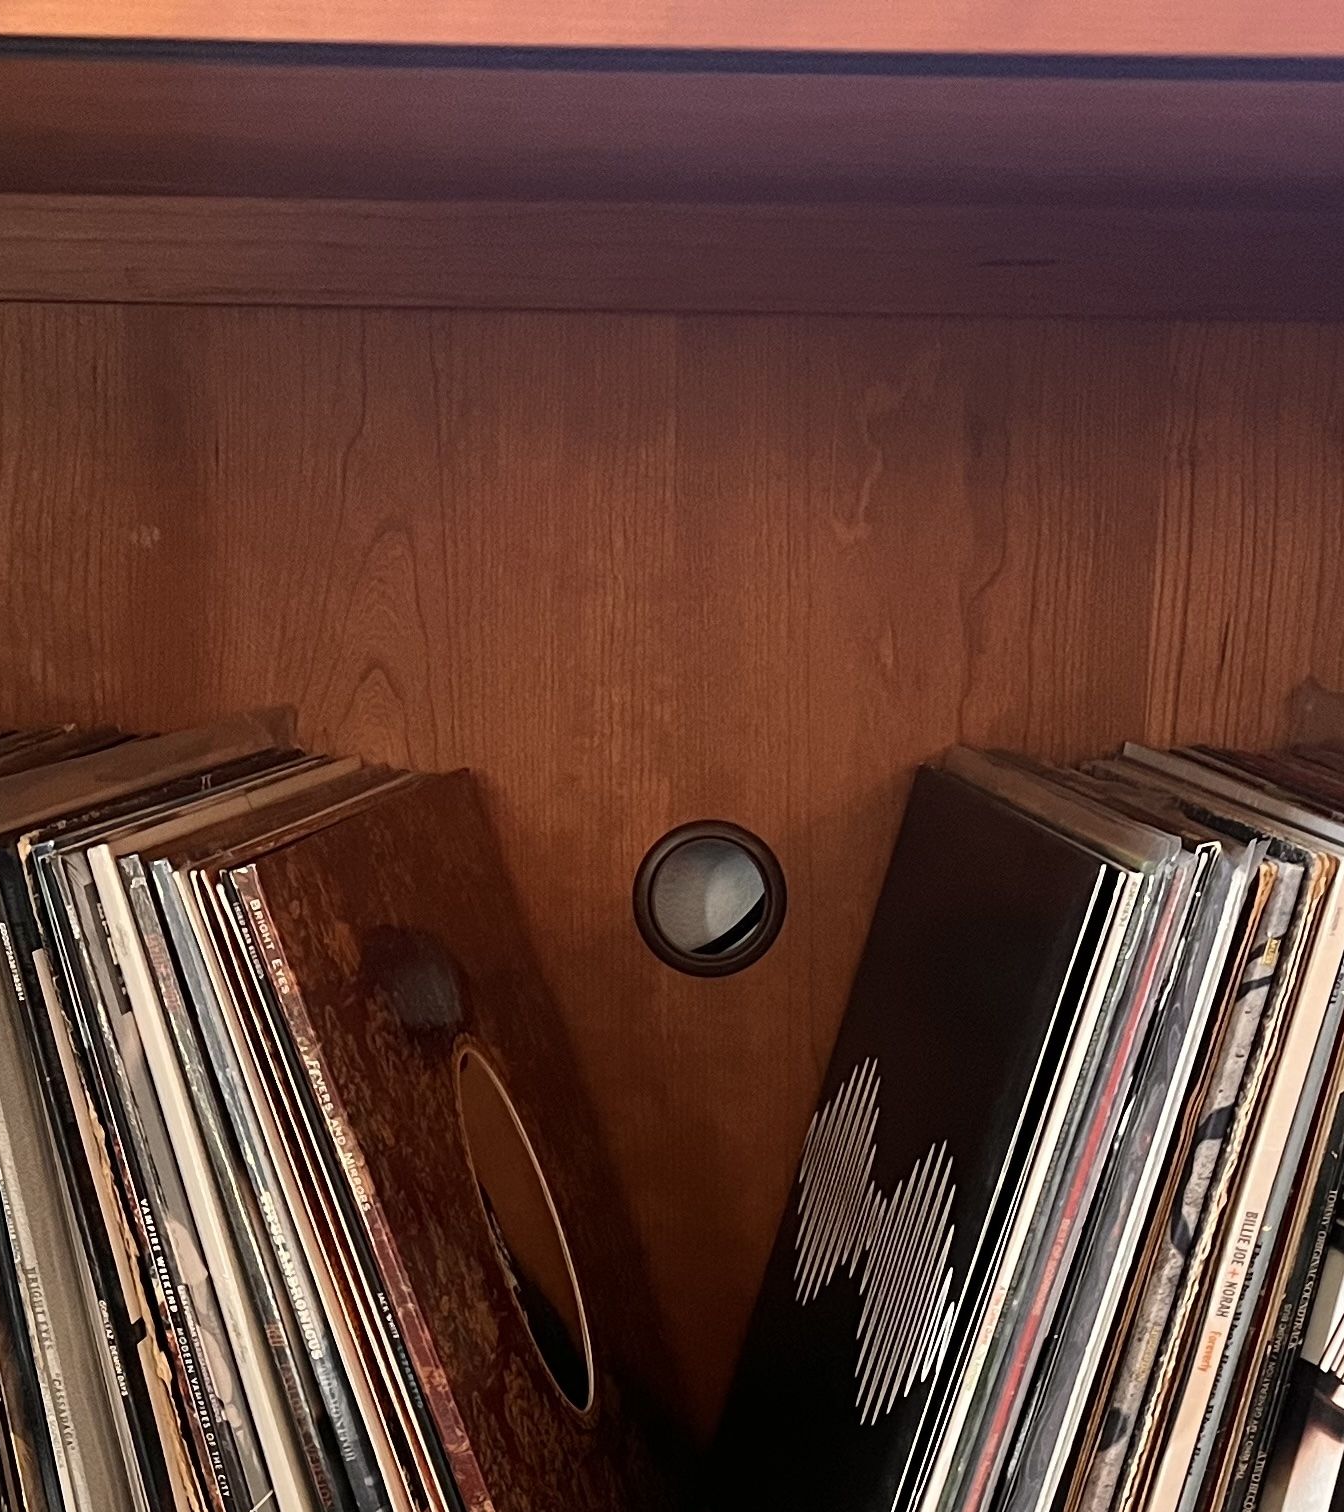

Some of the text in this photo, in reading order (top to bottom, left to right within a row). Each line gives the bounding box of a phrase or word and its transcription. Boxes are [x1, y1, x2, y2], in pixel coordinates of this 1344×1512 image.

[247, 896, 292, 995] BRIGHT EYES
[305, 1056, 373, 1213] FEVERS AND MIRRORS
[258, 1190, 323, 1361] TITUS ANDRONICUS
[1215, 1209, 1258, 1319] BILLIE JOE + NORAH
[1286, 1188, 1338, 1351] TOMMY ORIGINAL SOUNDTRACK
[98, 1298, 128, 1397] GORILLAZ DEMON DAYS
[139, 1197, 230, 1499] VAMPIRE WEEKEND MODERN VAMPIRES OF THE CITY
[376, 1290, 425, 1409] JACK WHITE LAZARETTO
[1197, 1328, 1222, 1373] Foreverly
[1271, 1323, 1286, 1353] MAGIC
[1279, 1302, 1292, 1323] BUS
[325, 1394, 356, 1462] MONITOR
[1252, 1360, 1275, 1418] GENERATION
[1235, 1462, 1247, 1480] THE
[1240, 1438, 1253, 1462] WHO
[1251, 1458, 1265, 1482] TWO
